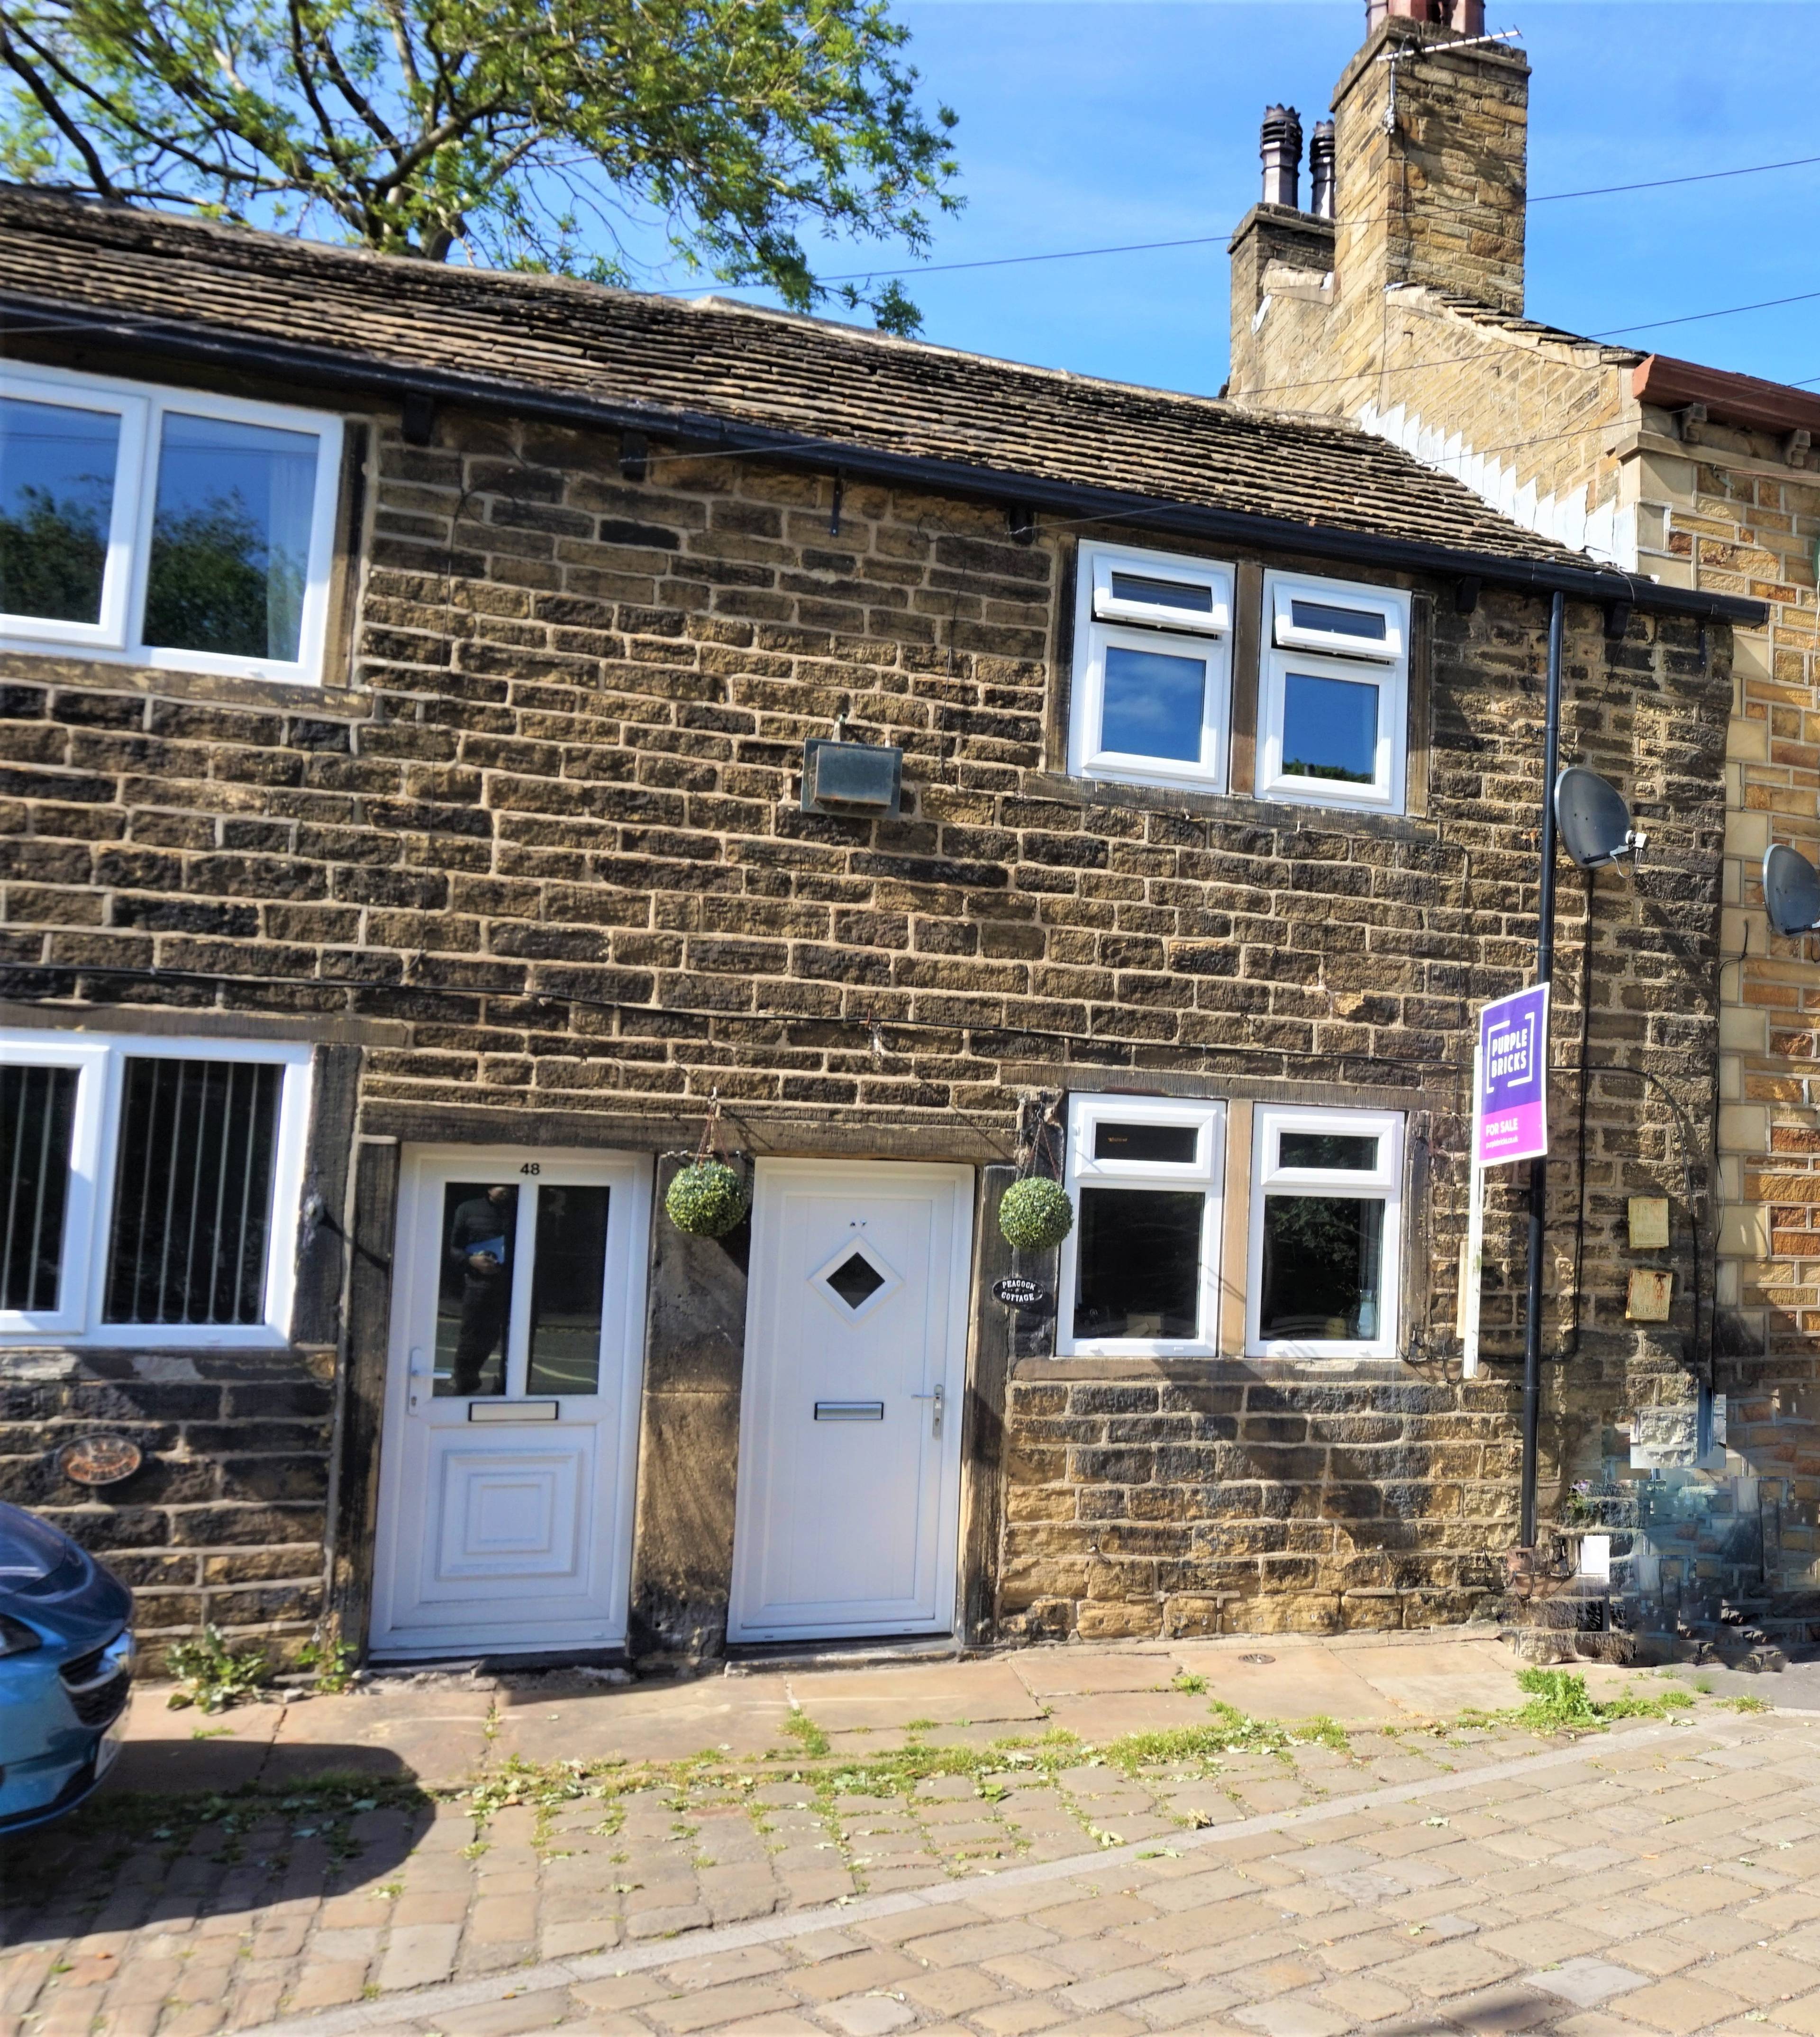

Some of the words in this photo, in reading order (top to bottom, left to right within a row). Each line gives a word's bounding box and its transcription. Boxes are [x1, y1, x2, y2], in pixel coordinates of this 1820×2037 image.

[1492, 1028, 1527, 1057] PURPLE
[1492, 1050, 1526, 1078] BRICKS
[1486, 1124, 1499, 1137] FOR
[1501, 1118, 1518, 1133] SALE
[520, 1163, 539, 1175] 48
[1002, 1280, 1036, 1290] PEACOCK
[1001, 1292, 1034, 1302] COTTAGE
